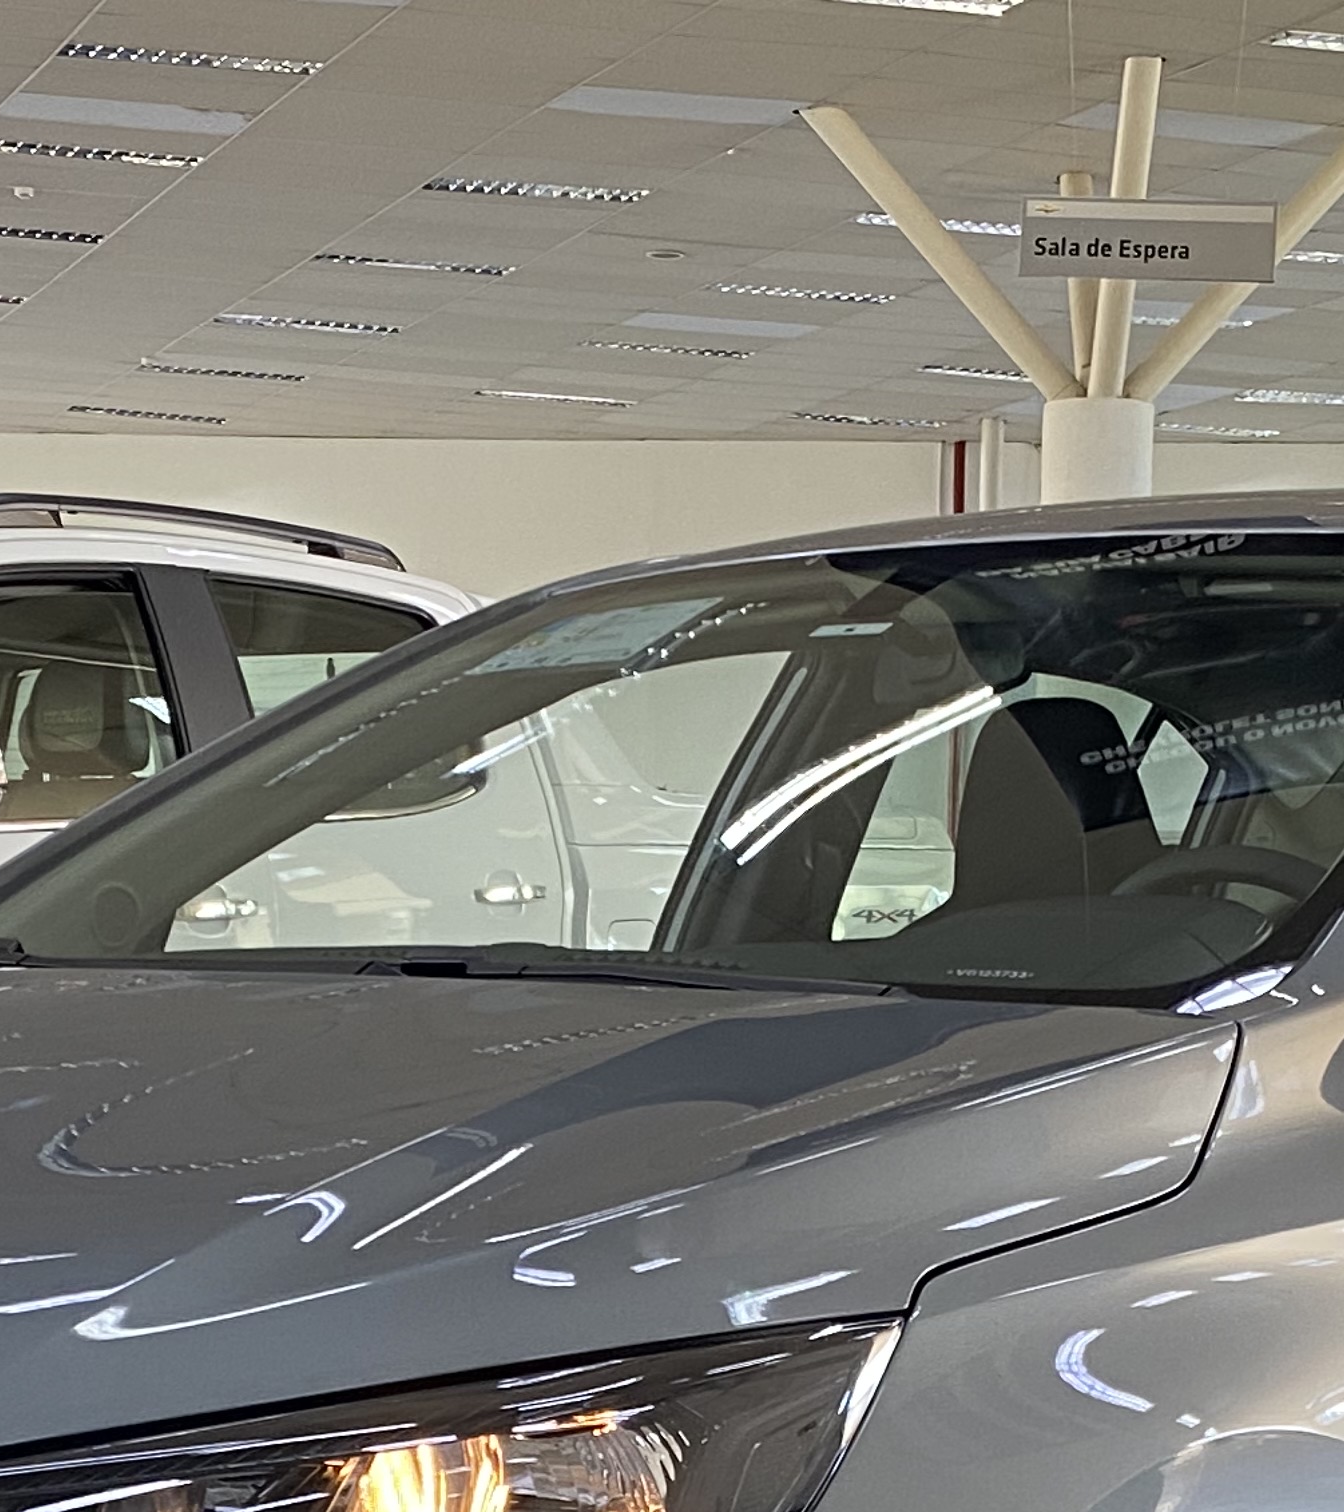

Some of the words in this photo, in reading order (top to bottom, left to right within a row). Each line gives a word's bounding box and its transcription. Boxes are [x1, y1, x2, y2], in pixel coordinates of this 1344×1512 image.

[1033, 236, 1081, 257] Sala
[1086, 237, 1113, 258] de
[1118, 239, 1190, 264] Espera
